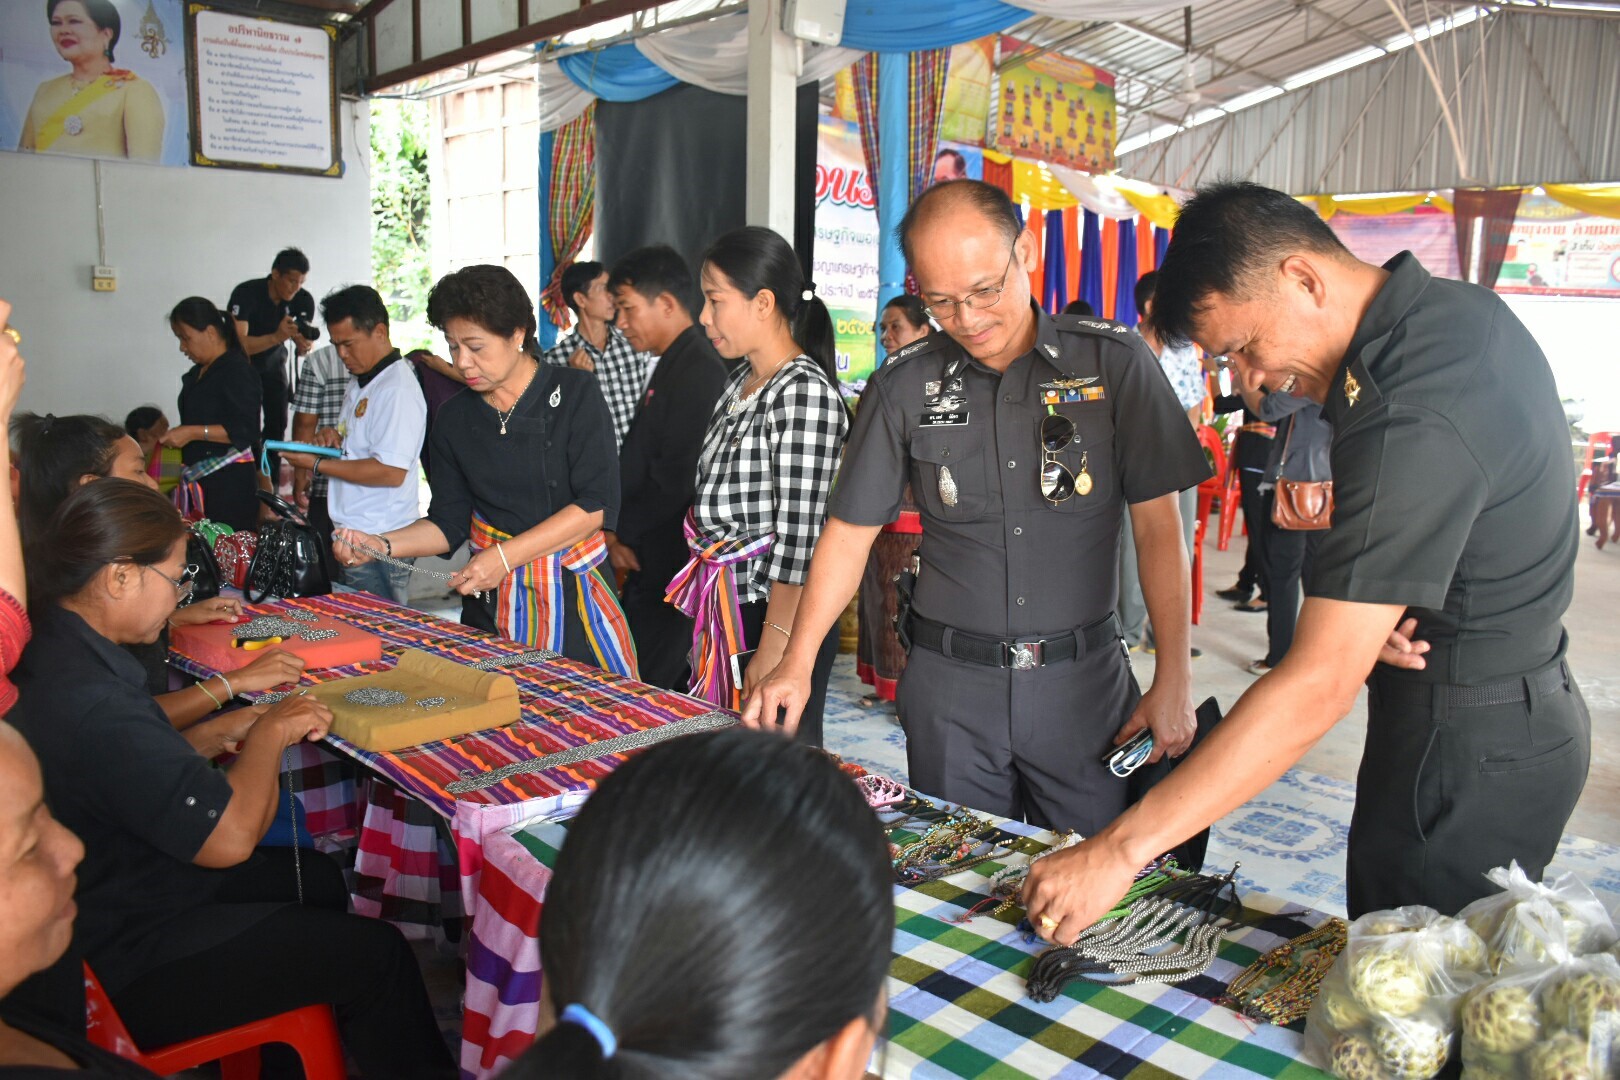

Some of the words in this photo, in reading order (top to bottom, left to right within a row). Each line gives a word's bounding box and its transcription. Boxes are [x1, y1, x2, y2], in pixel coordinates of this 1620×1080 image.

[228, 24, 290, 42] อปริหานิยธรรม
[814, 226, 879, 248] รษฐกิจพอเ
